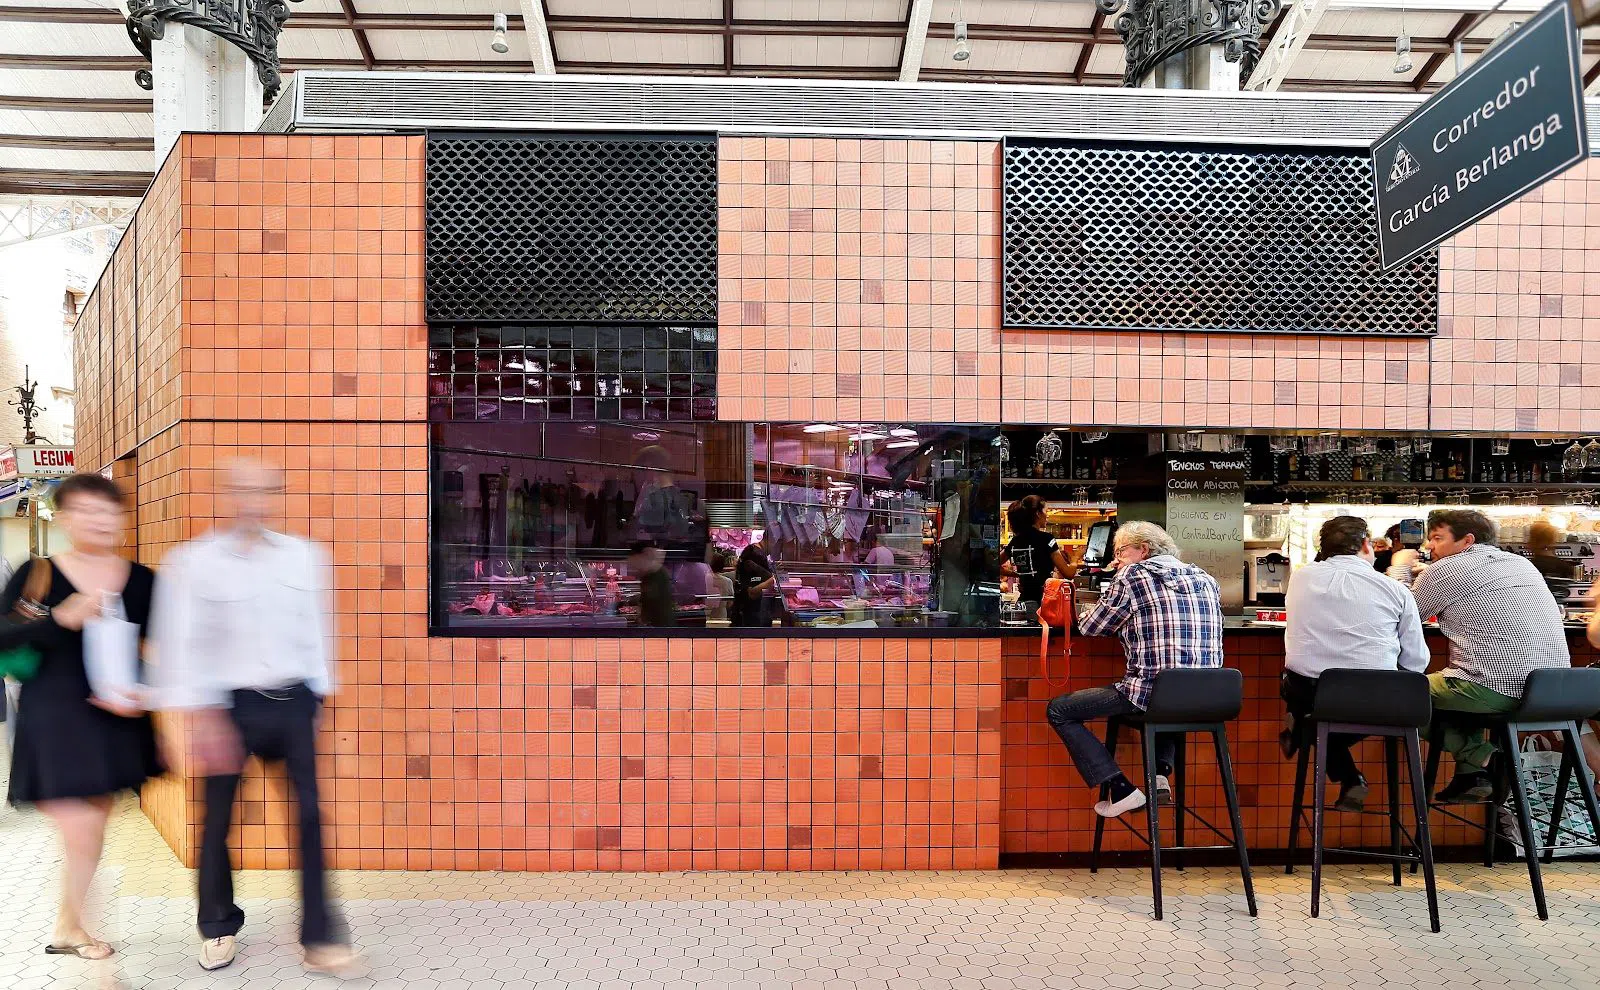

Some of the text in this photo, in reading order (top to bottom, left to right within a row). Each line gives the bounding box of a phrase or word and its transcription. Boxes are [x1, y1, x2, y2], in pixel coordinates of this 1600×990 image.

[1432, 65, 1540, 153] Corredor
[1389, 183, 1451, 233] García
[1455, 112, 1563, 193] Berlanga
[33, 450, 74, 466] LEGUM
